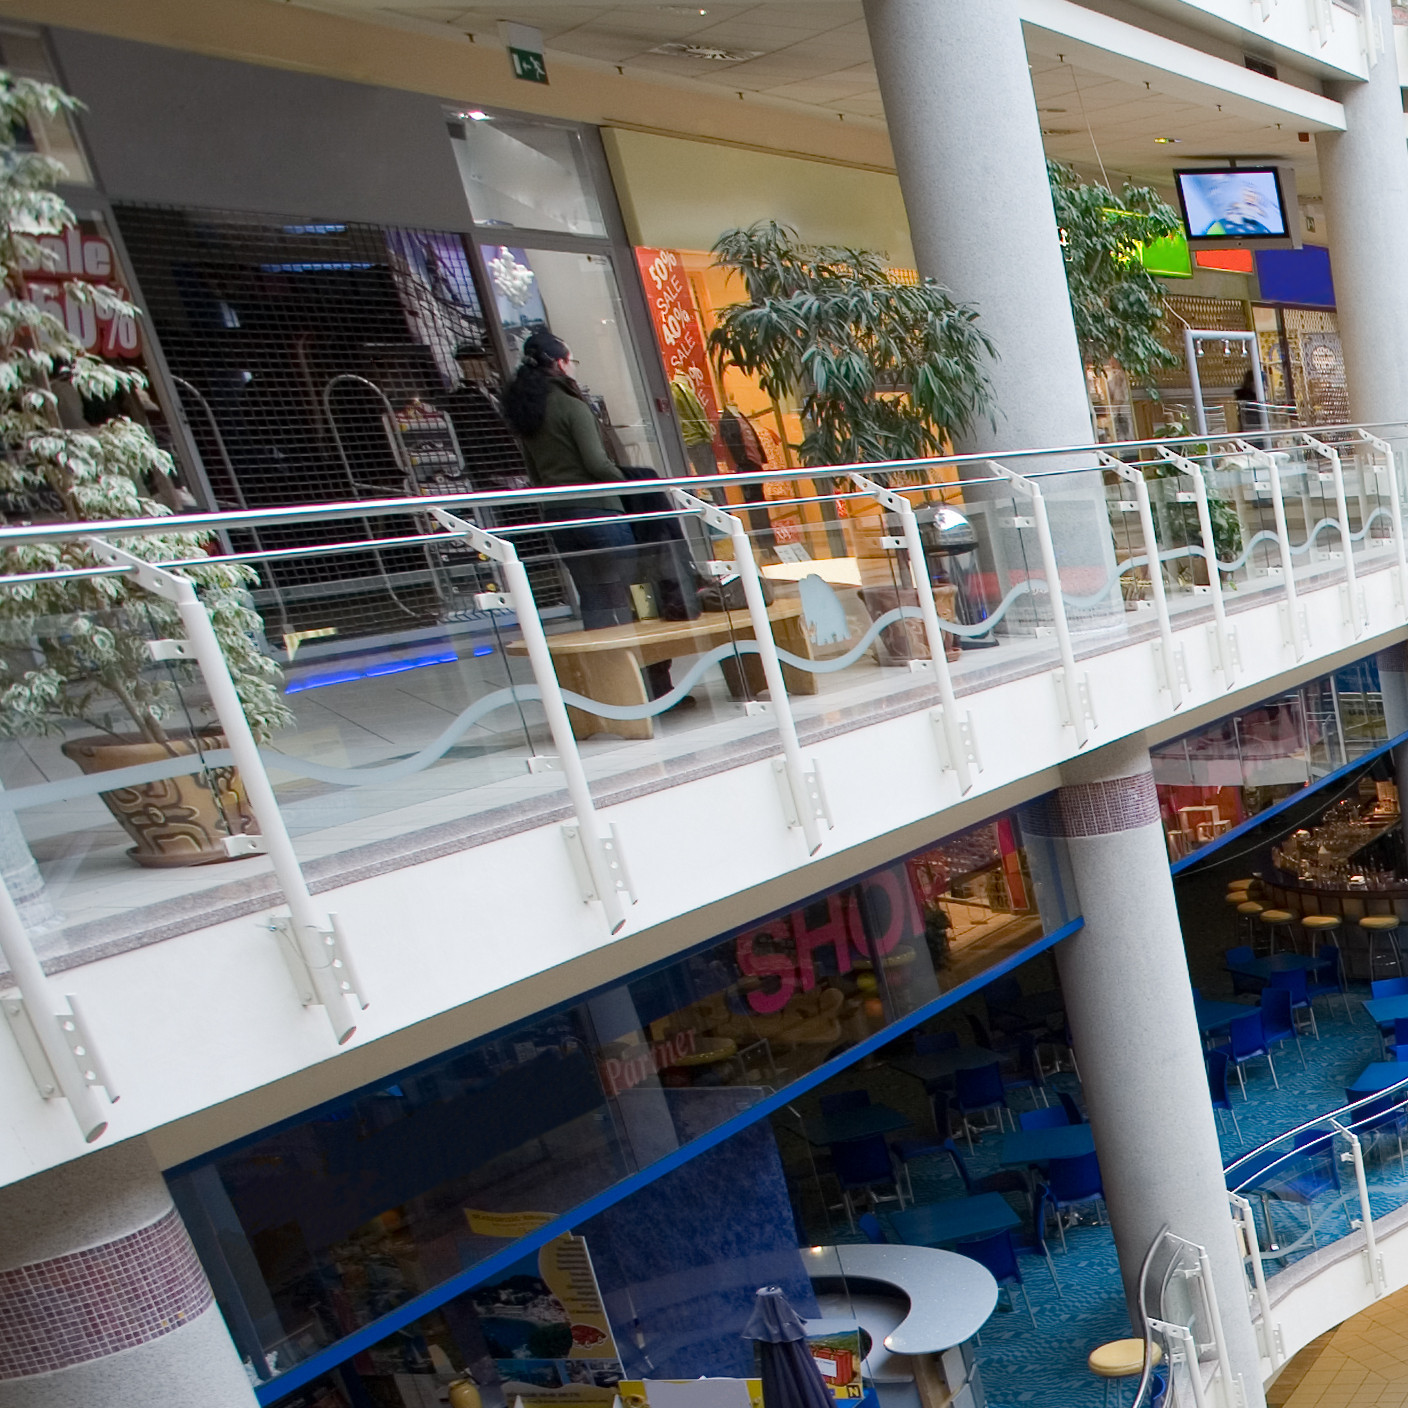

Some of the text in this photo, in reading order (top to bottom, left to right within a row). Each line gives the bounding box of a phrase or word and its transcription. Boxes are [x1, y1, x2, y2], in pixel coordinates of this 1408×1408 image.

[649, 250, 678, 291] 50%
[656, 275, 683, 314] SALE
[670, 332, 696, 368] SALE
[602, 1027, 697, 1096] Partner
